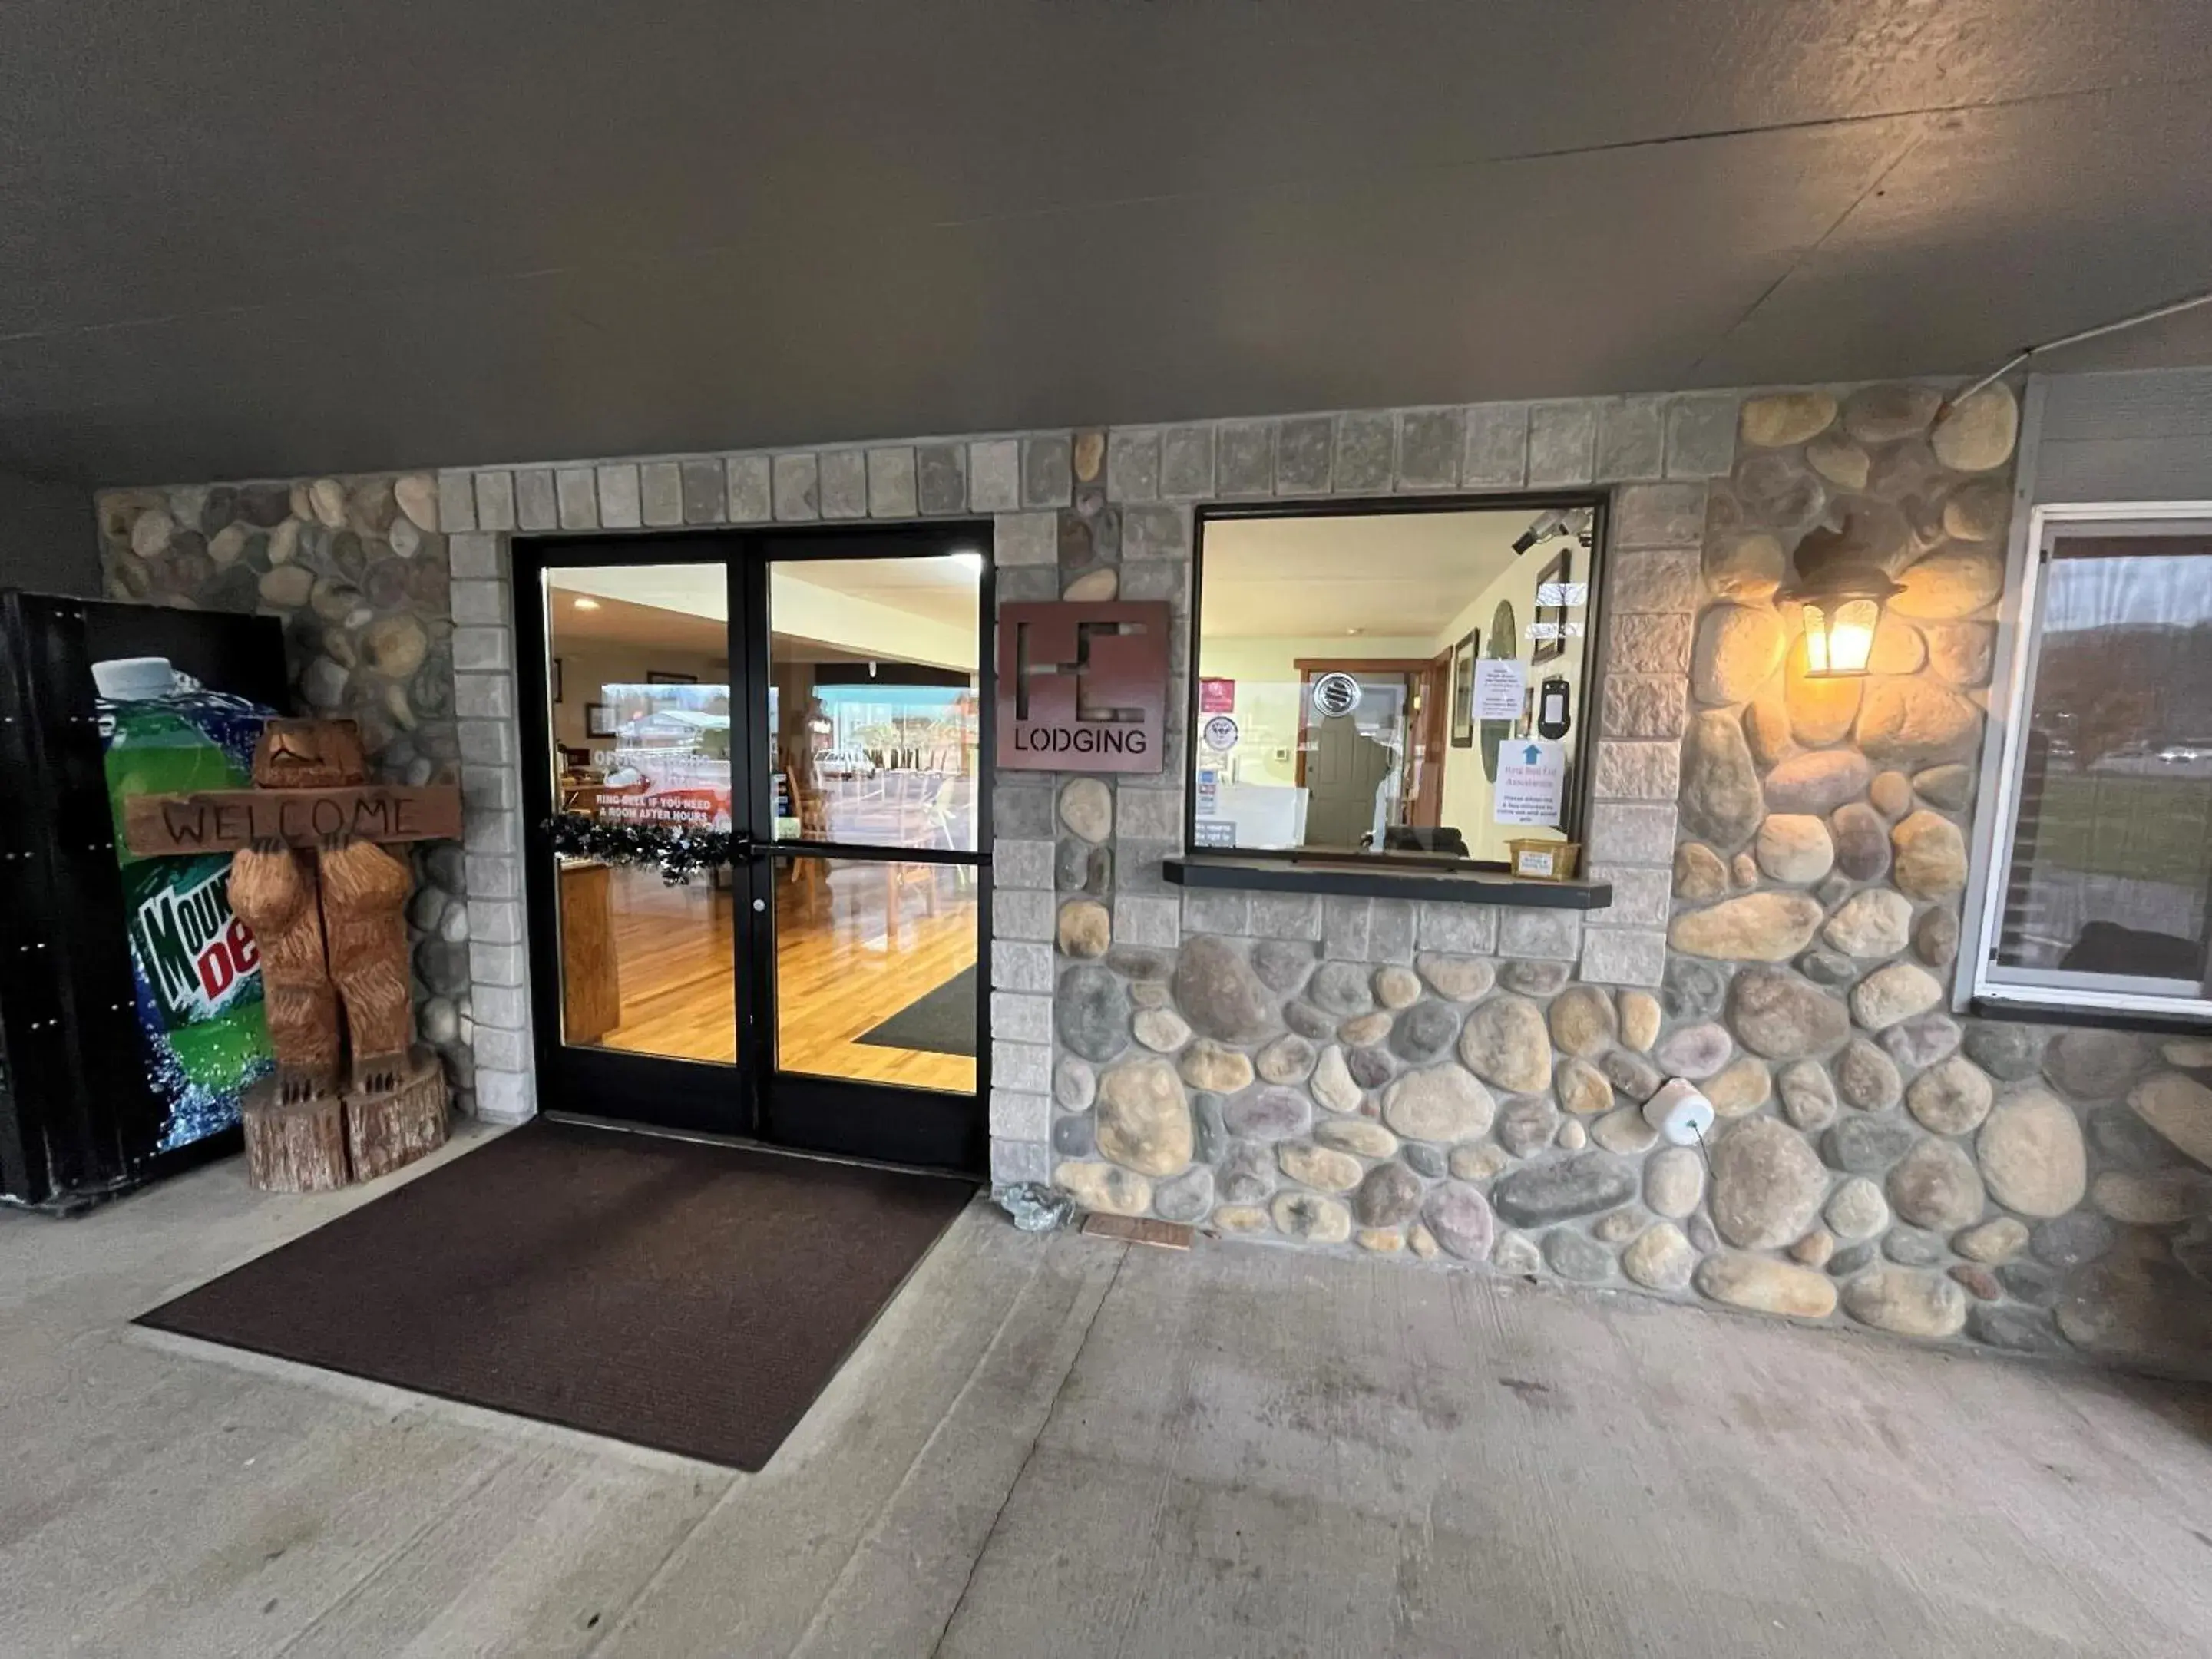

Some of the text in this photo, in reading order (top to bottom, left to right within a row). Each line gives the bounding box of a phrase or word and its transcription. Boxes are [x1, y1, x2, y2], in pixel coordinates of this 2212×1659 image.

[1014, 728, 1147, 754] LODGING
[597, 794, 620, 805] RING
[648, 796, 657, 808] IF
[660, 797, 681, 808] YOU
[683, 798, 711, 810] NEED
[160, 798, 421, 844] WELCOME
[599, 807, 708, 822] A ROOM AFTER HOURS
